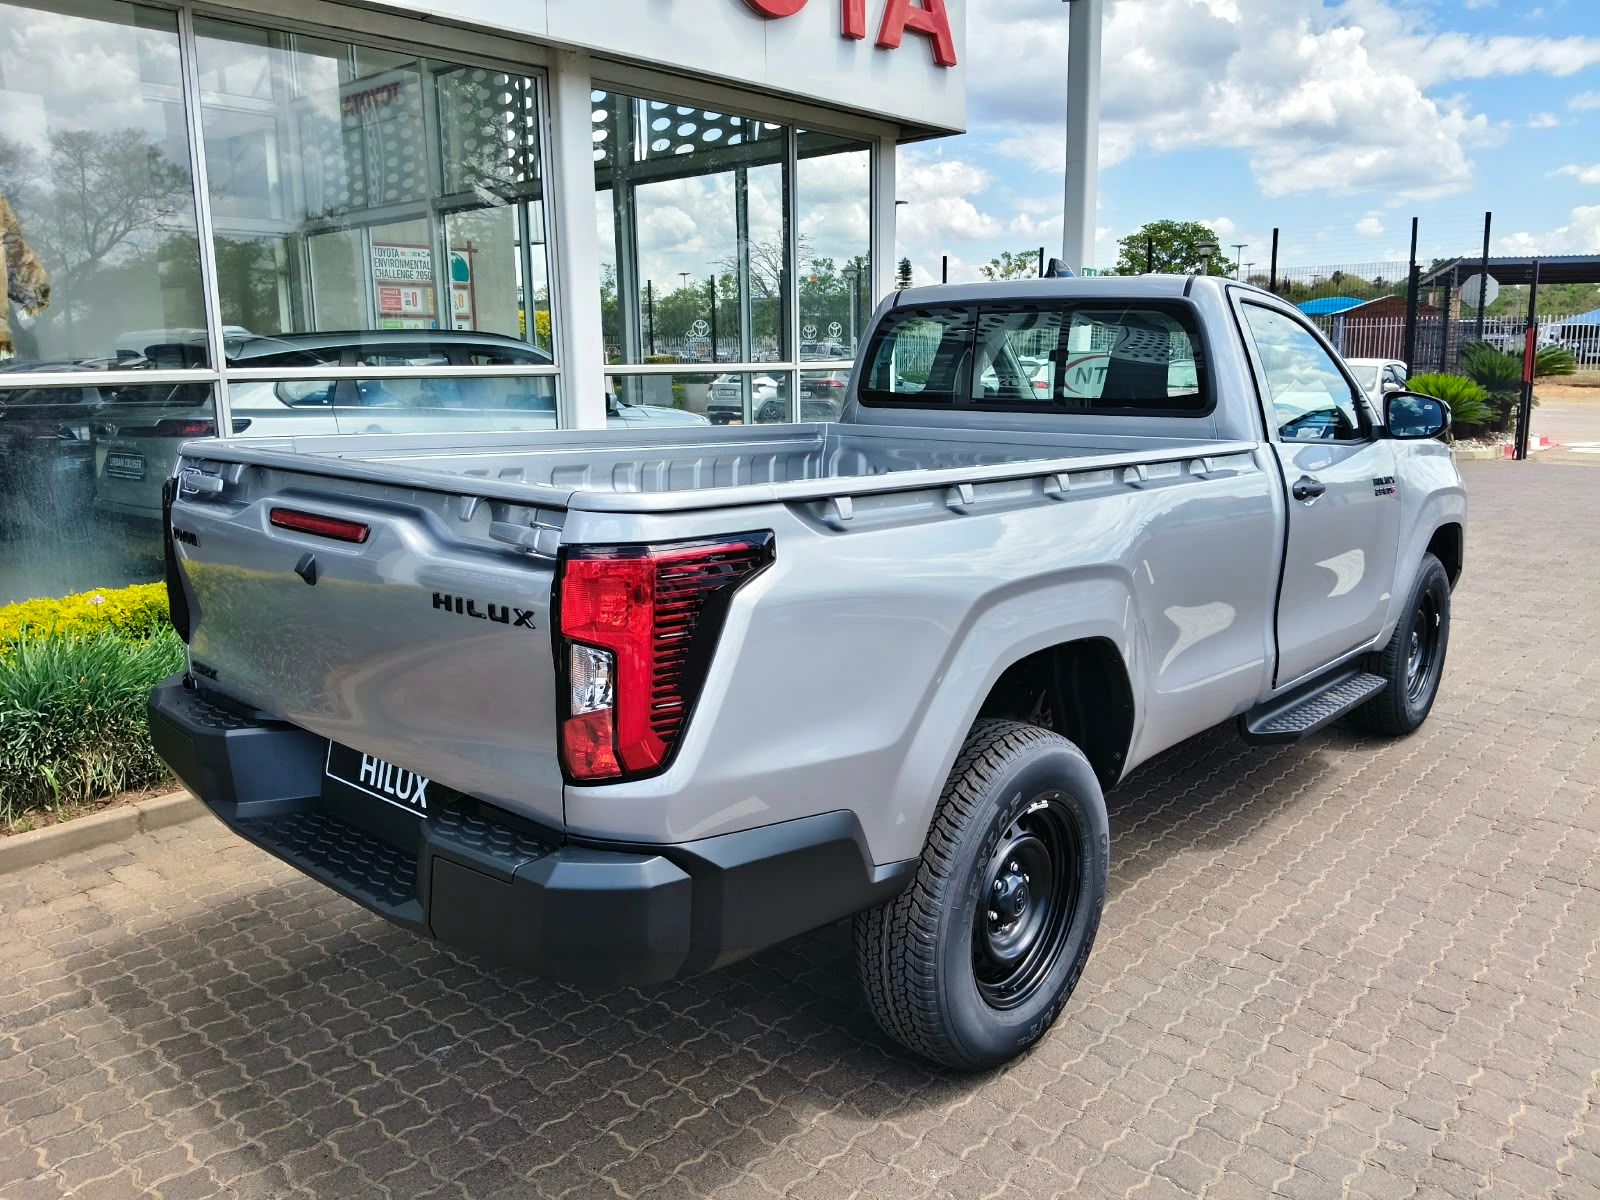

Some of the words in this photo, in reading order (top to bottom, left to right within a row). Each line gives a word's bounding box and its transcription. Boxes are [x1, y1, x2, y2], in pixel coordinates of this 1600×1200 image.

[374, 247, 400, 258] TOYOTA
[374, 258, 432, 270] ENVIRONMENTAL
[375, 269, 414, 280] CHALLENGE
[416, 270, 433, 280] 2050
[432, 591, 536, 630] HILUX
[359, 753, 430, 809] HILUX
